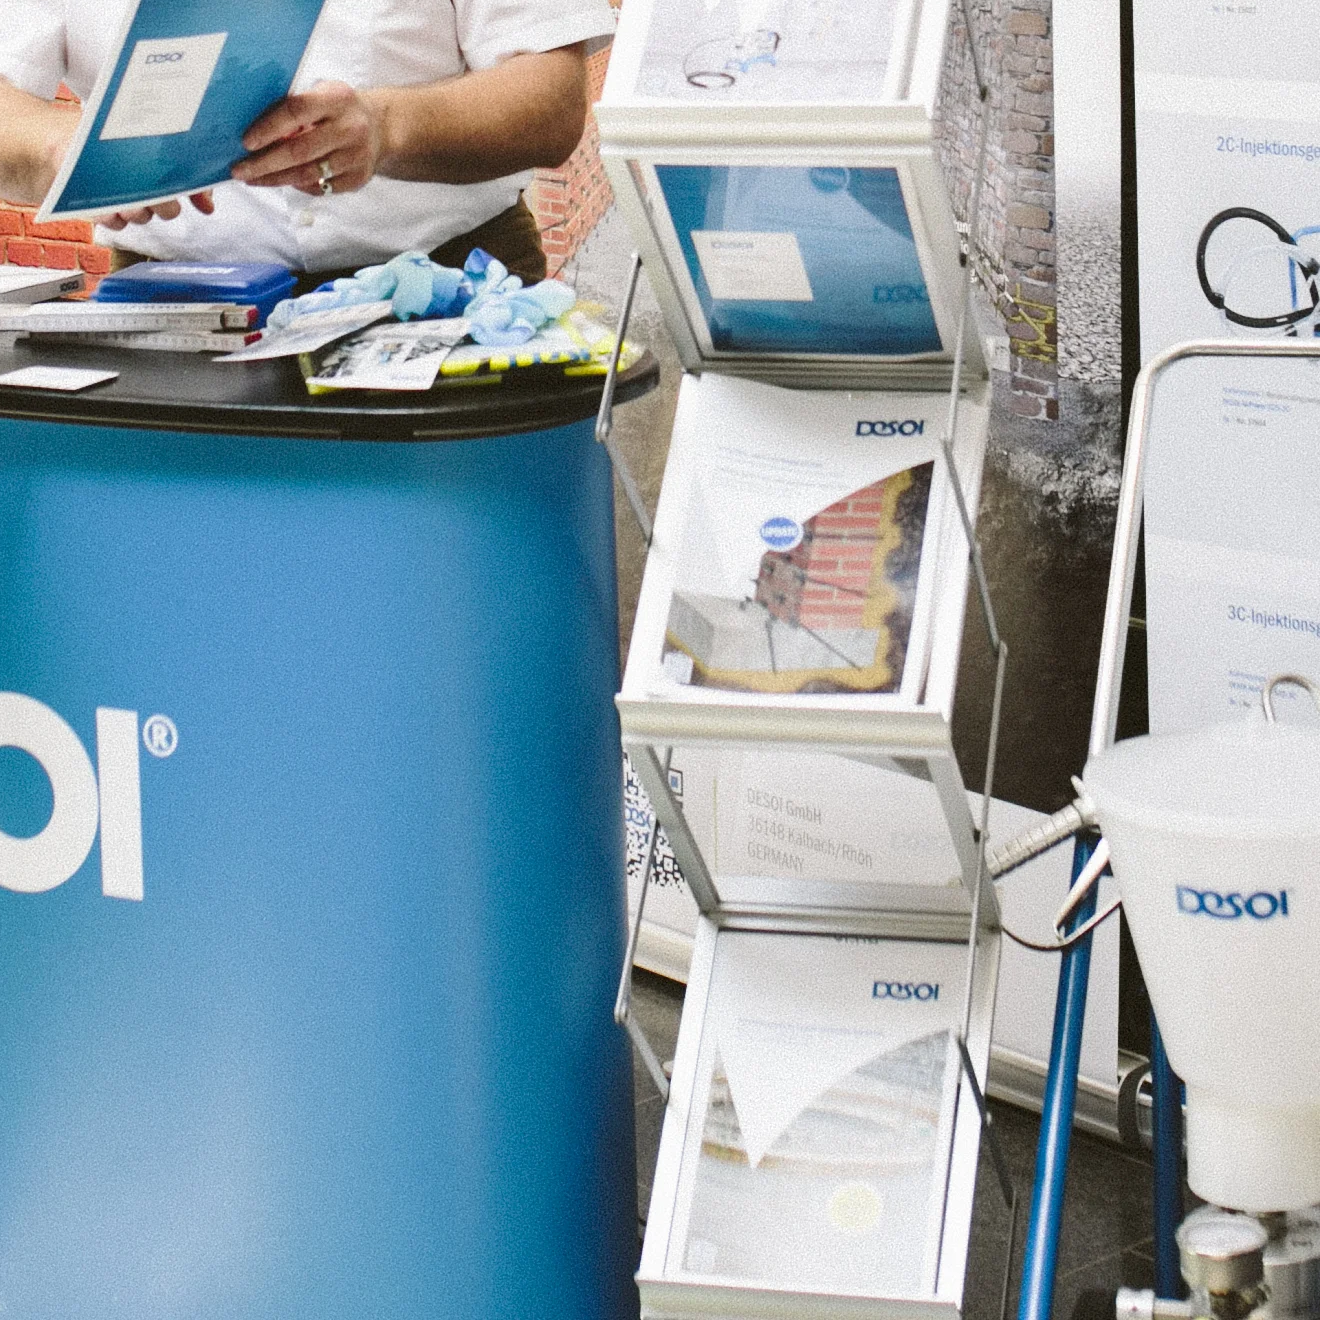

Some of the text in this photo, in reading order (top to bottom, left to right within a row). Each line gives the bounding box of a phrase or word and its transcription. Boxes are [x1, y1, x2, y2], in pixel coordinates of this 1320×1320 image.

[747, 787, 823, 826] DESOI GmbH
[747, 814, 785, 841] 36148
[747, 841, 805, 872] GERMANY
